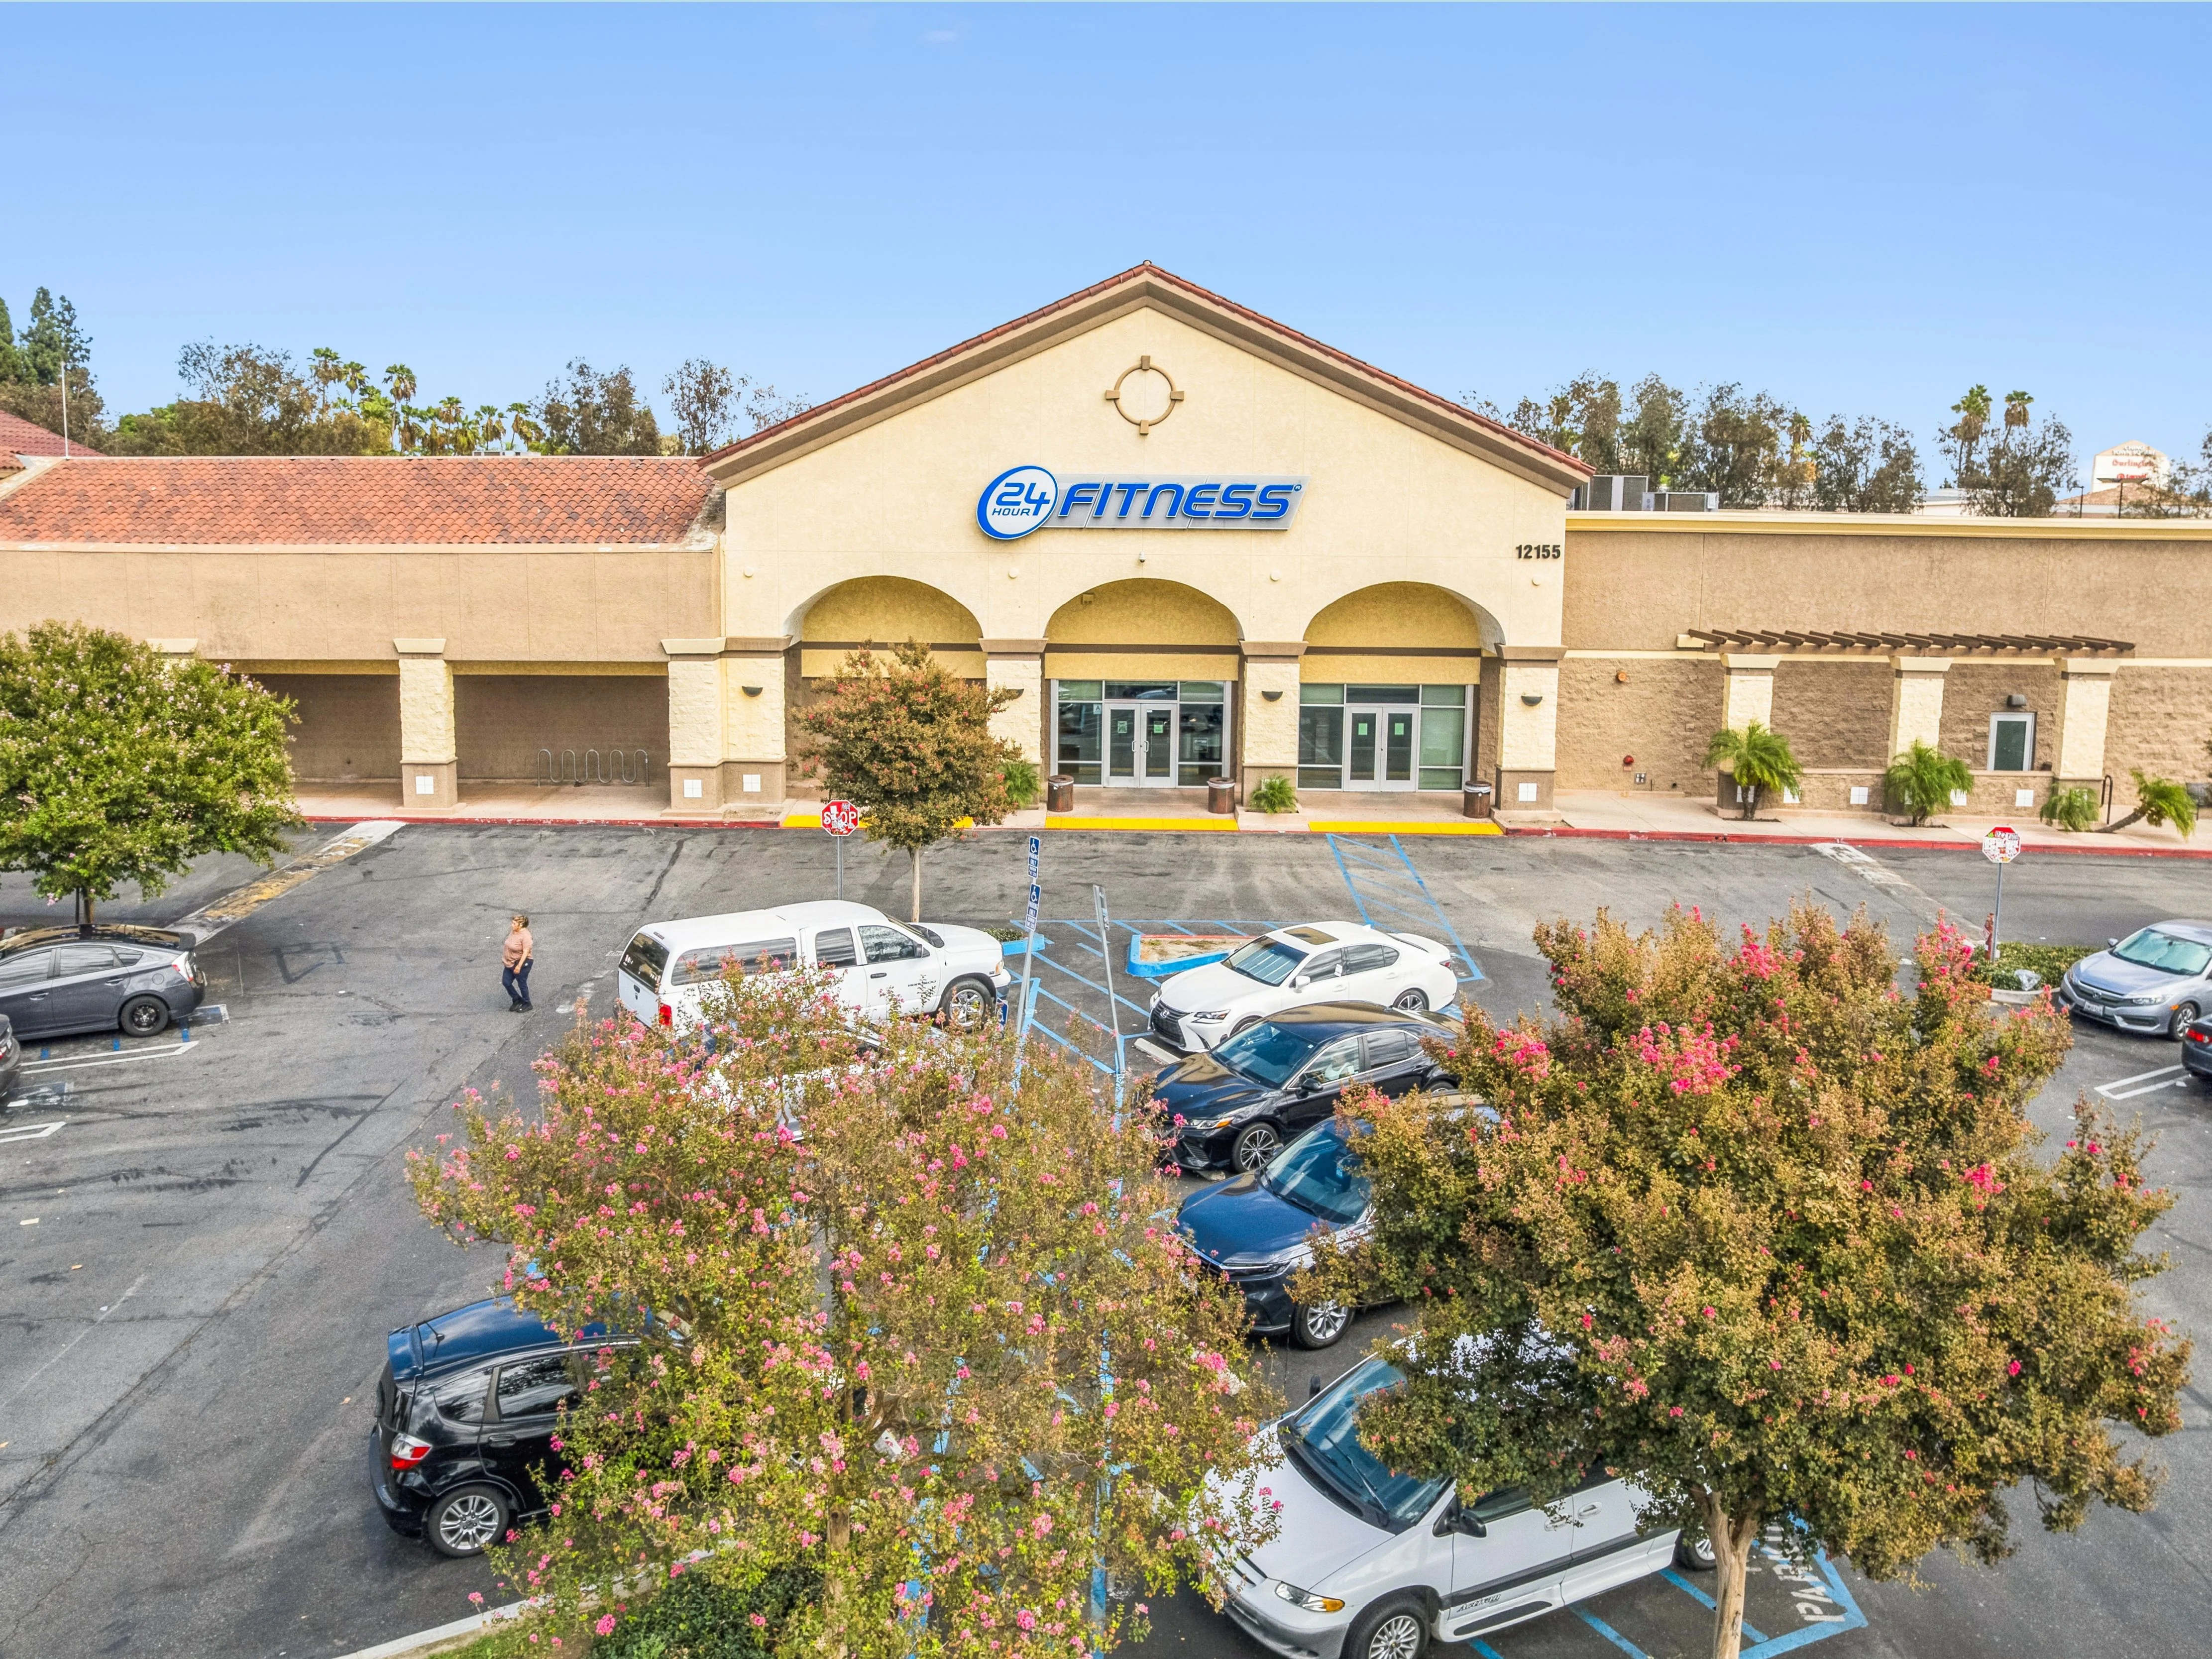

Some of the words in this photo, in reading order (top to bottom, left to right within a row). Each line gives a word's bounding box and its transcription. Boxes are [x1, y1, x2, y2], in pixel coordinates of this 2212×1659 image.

[992, 508, 1031, 516] HOUR
[995, 482, 1051, 516] 24
[1058, 483, 1295, 519] FITNESS
[1516, 545, 1561, 559] 12155
[1760, 1525, 1846, 1622] PARKI
